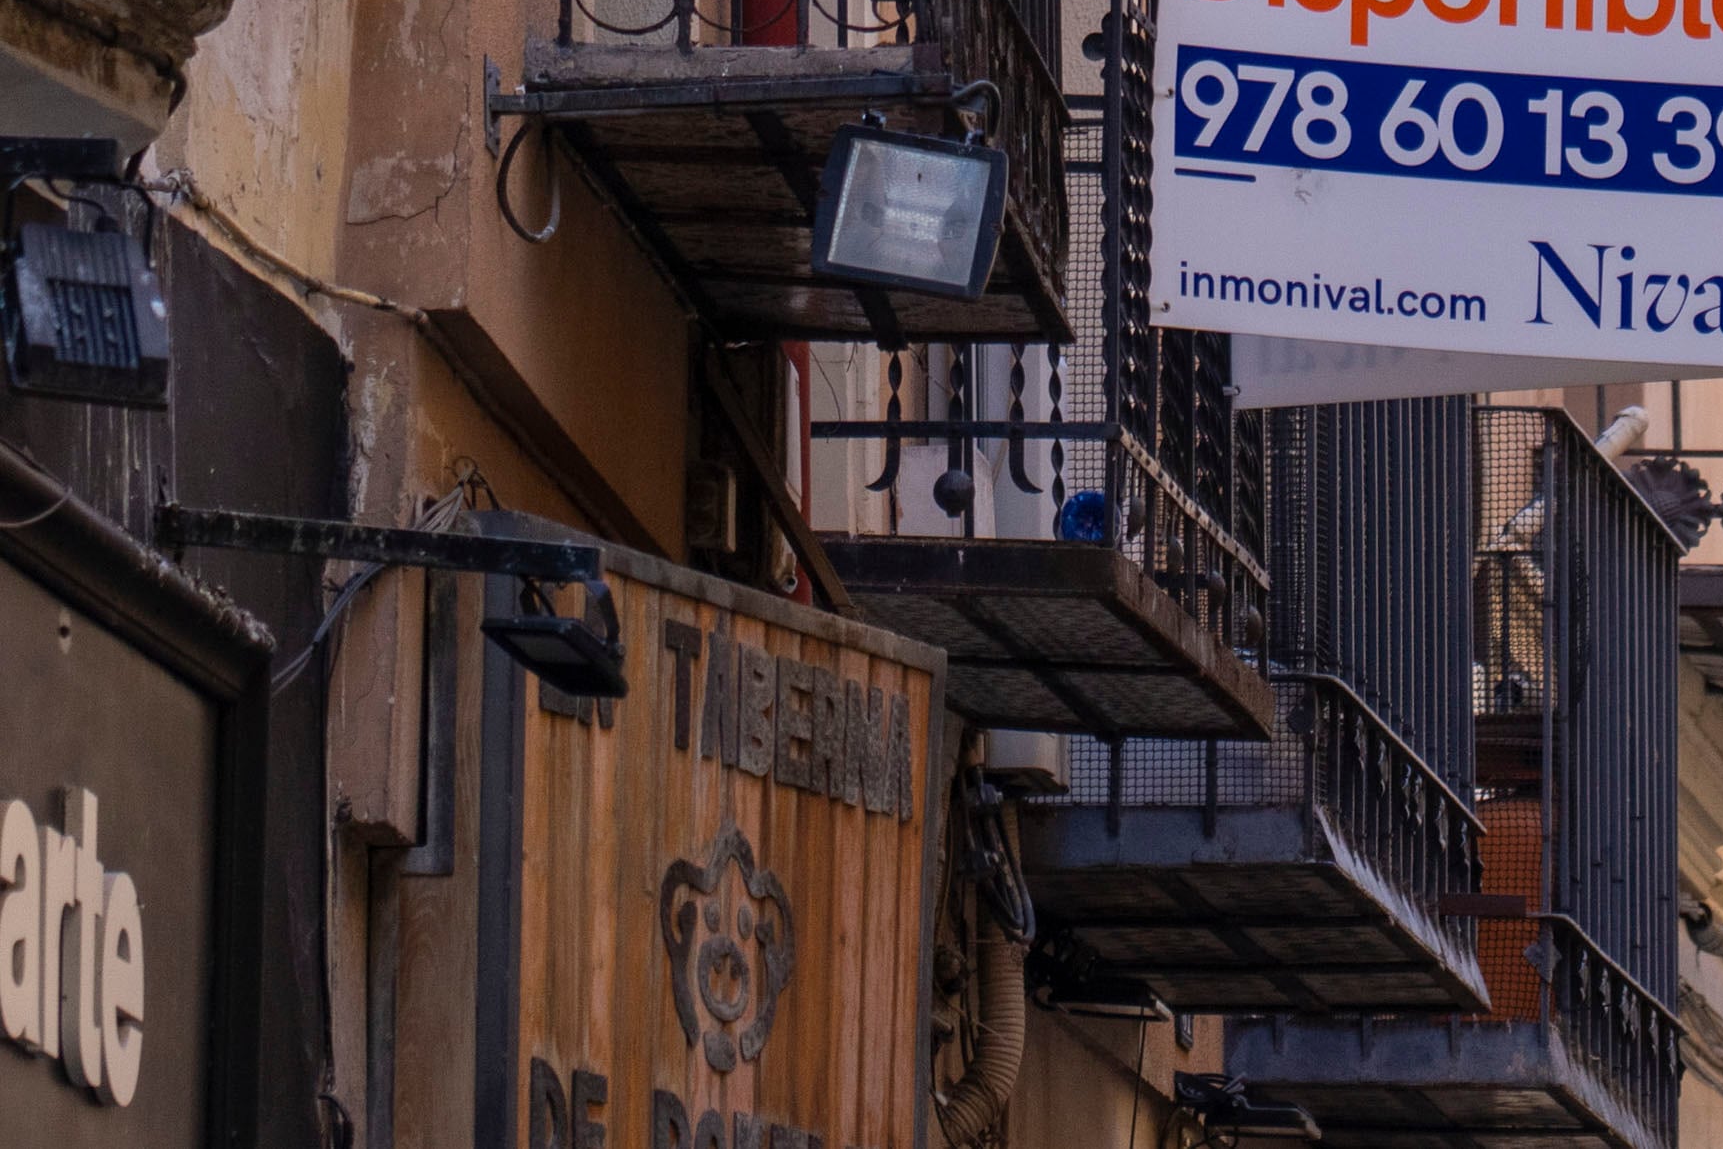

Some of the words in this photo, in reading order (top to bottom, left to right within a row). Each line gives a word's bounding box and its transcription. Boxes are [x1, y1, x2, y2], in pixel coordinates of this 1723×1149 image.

[1181, 60, 1352, 159] 978
[1380, 79, 1504, 171] 60
[1528, 89, 1628, 179] 13
[1180, 261, 1487, 323] inmonival.com
[665, 618, 913, 822] TABERNA
